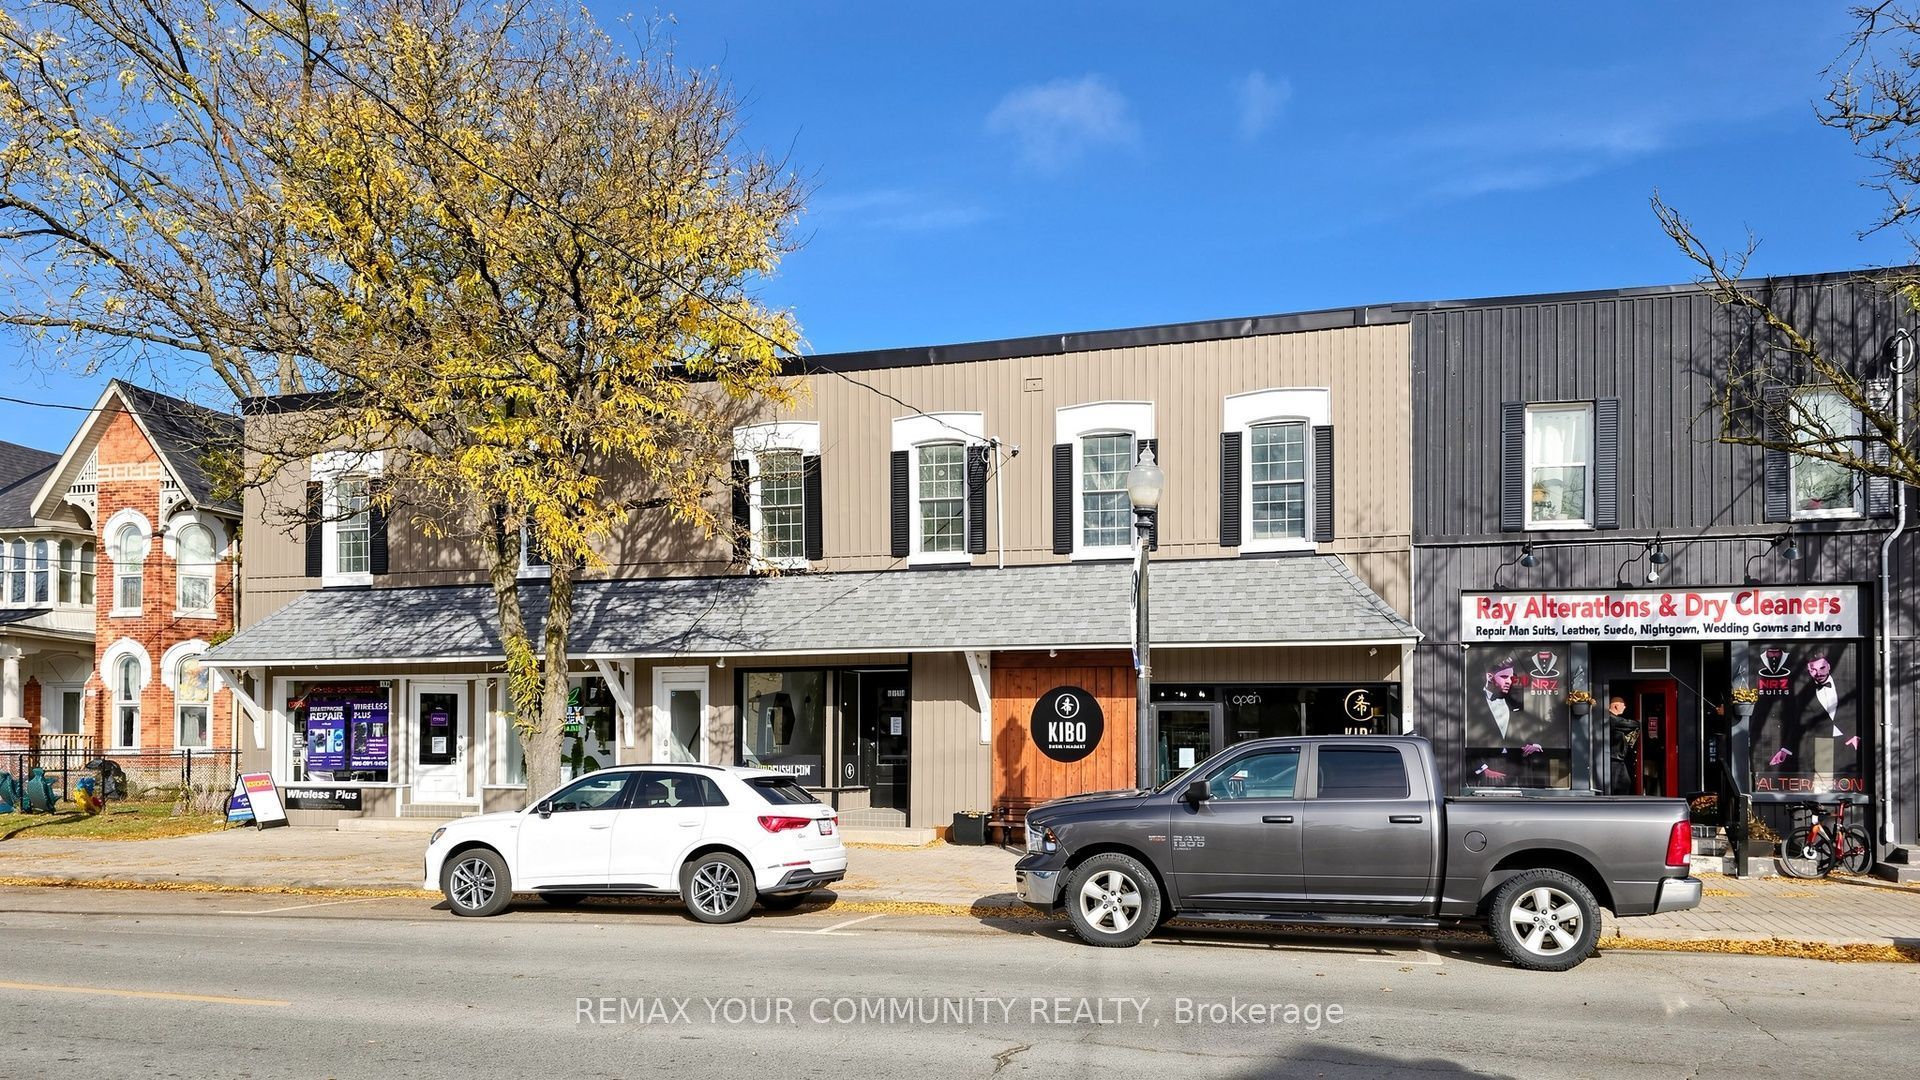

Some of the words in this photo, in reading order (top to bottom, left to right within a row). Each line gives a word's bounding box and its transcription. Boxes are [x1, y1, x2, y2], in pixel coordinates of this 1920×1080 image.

[1476, 597, 1517, 625] Ray
[1524, 594, 1651, 619] Alterations
[1659, 593, 1678, 617] &
[1685, 592, 1728, 622] Dry
[1735, 590, 1841, 616] Cleaners
[1476, 626, 1506, 638] Repair
[1509, 625, 1530, 636] Man
[1532, 624, 1559, 637] Suits,
[1562, 624, 1601, 637] Leather,
[1603, 624, 1637, 636] Suede,
[1640, 622, 1700, 637] Nightgown,
[1703, 622, 1749, 635] Wedding
[1752, 623, 1789, 633] Gowns
[1791, 622, 1811, 632] and
[1814, 621, 1842, 632] More
[1758, 679, 1790, 689] NRZ
[310, 712, 345, 720] REPAIR
[1049, 721, 1086, 742] KIBO
[286, 789, 330, 799] Wireless
[335, 790, 358, 800] Plus
